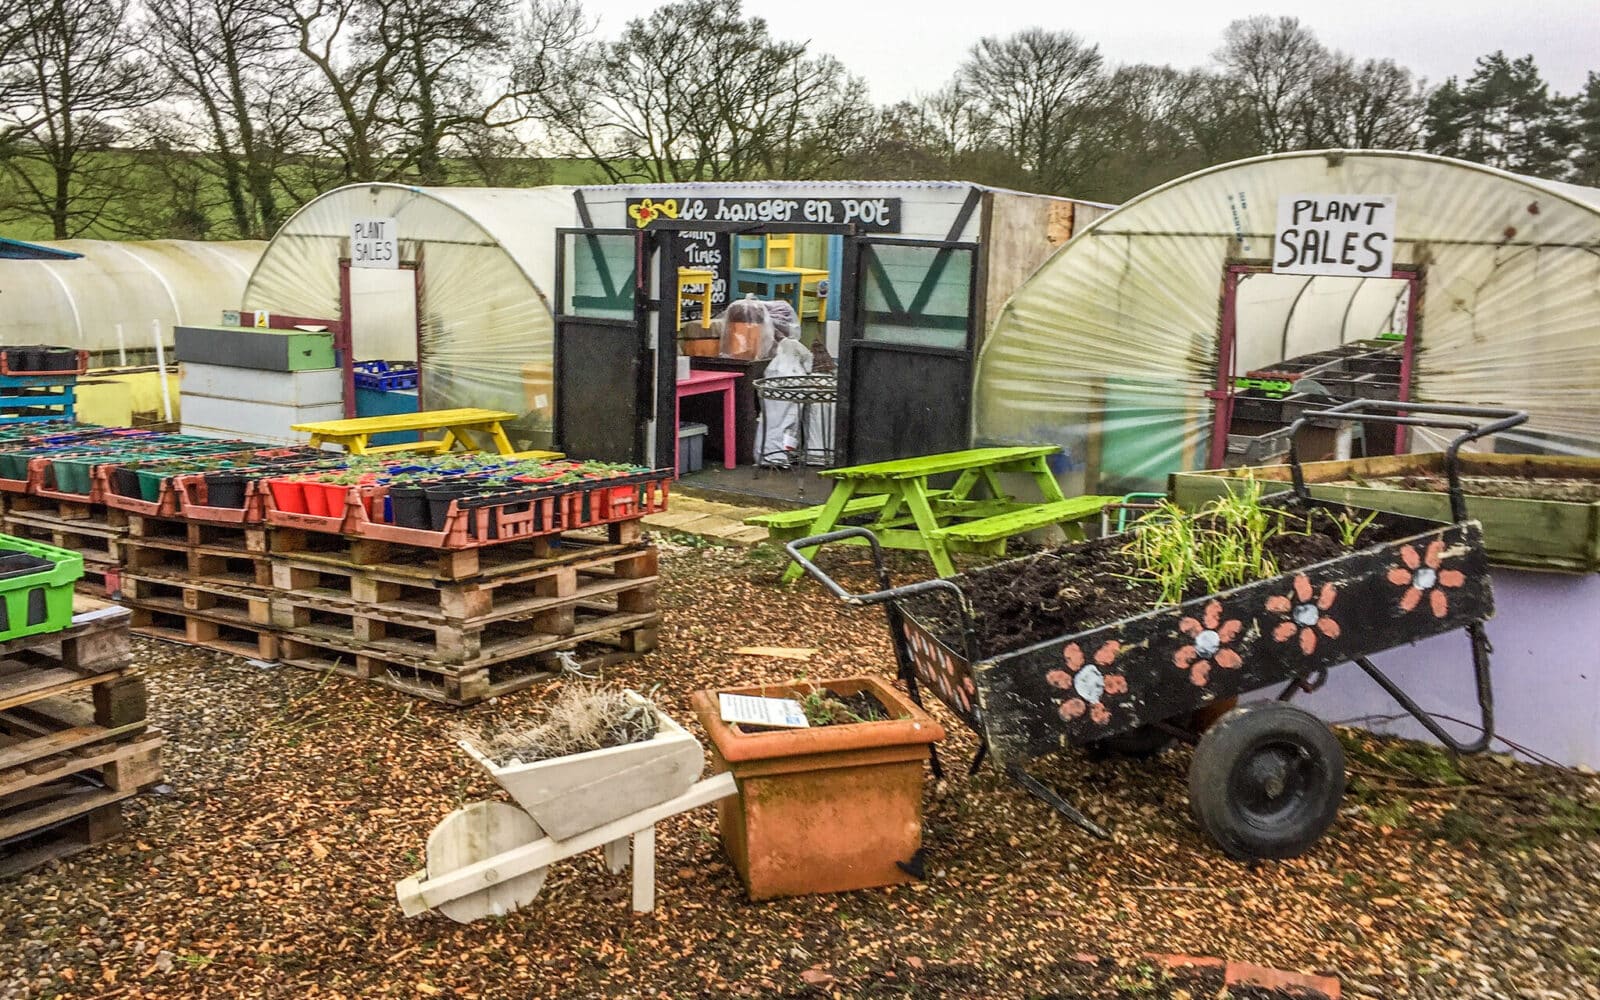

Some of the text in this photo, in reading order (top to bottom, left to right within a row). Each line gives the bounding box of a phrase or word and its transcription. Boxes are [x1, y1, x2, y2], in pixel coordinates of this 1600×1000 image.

[715, 198, 799, 221] hanger
[804, 199, 834, 223] en
[841, 198, 890, 226] pot
[1293, 199, 1385, 225] PLANT
[354, 221, 386, 239] PLANT
[355, 241, 392, 261] SALES
[1277, 229, 1388, 272] SALES
